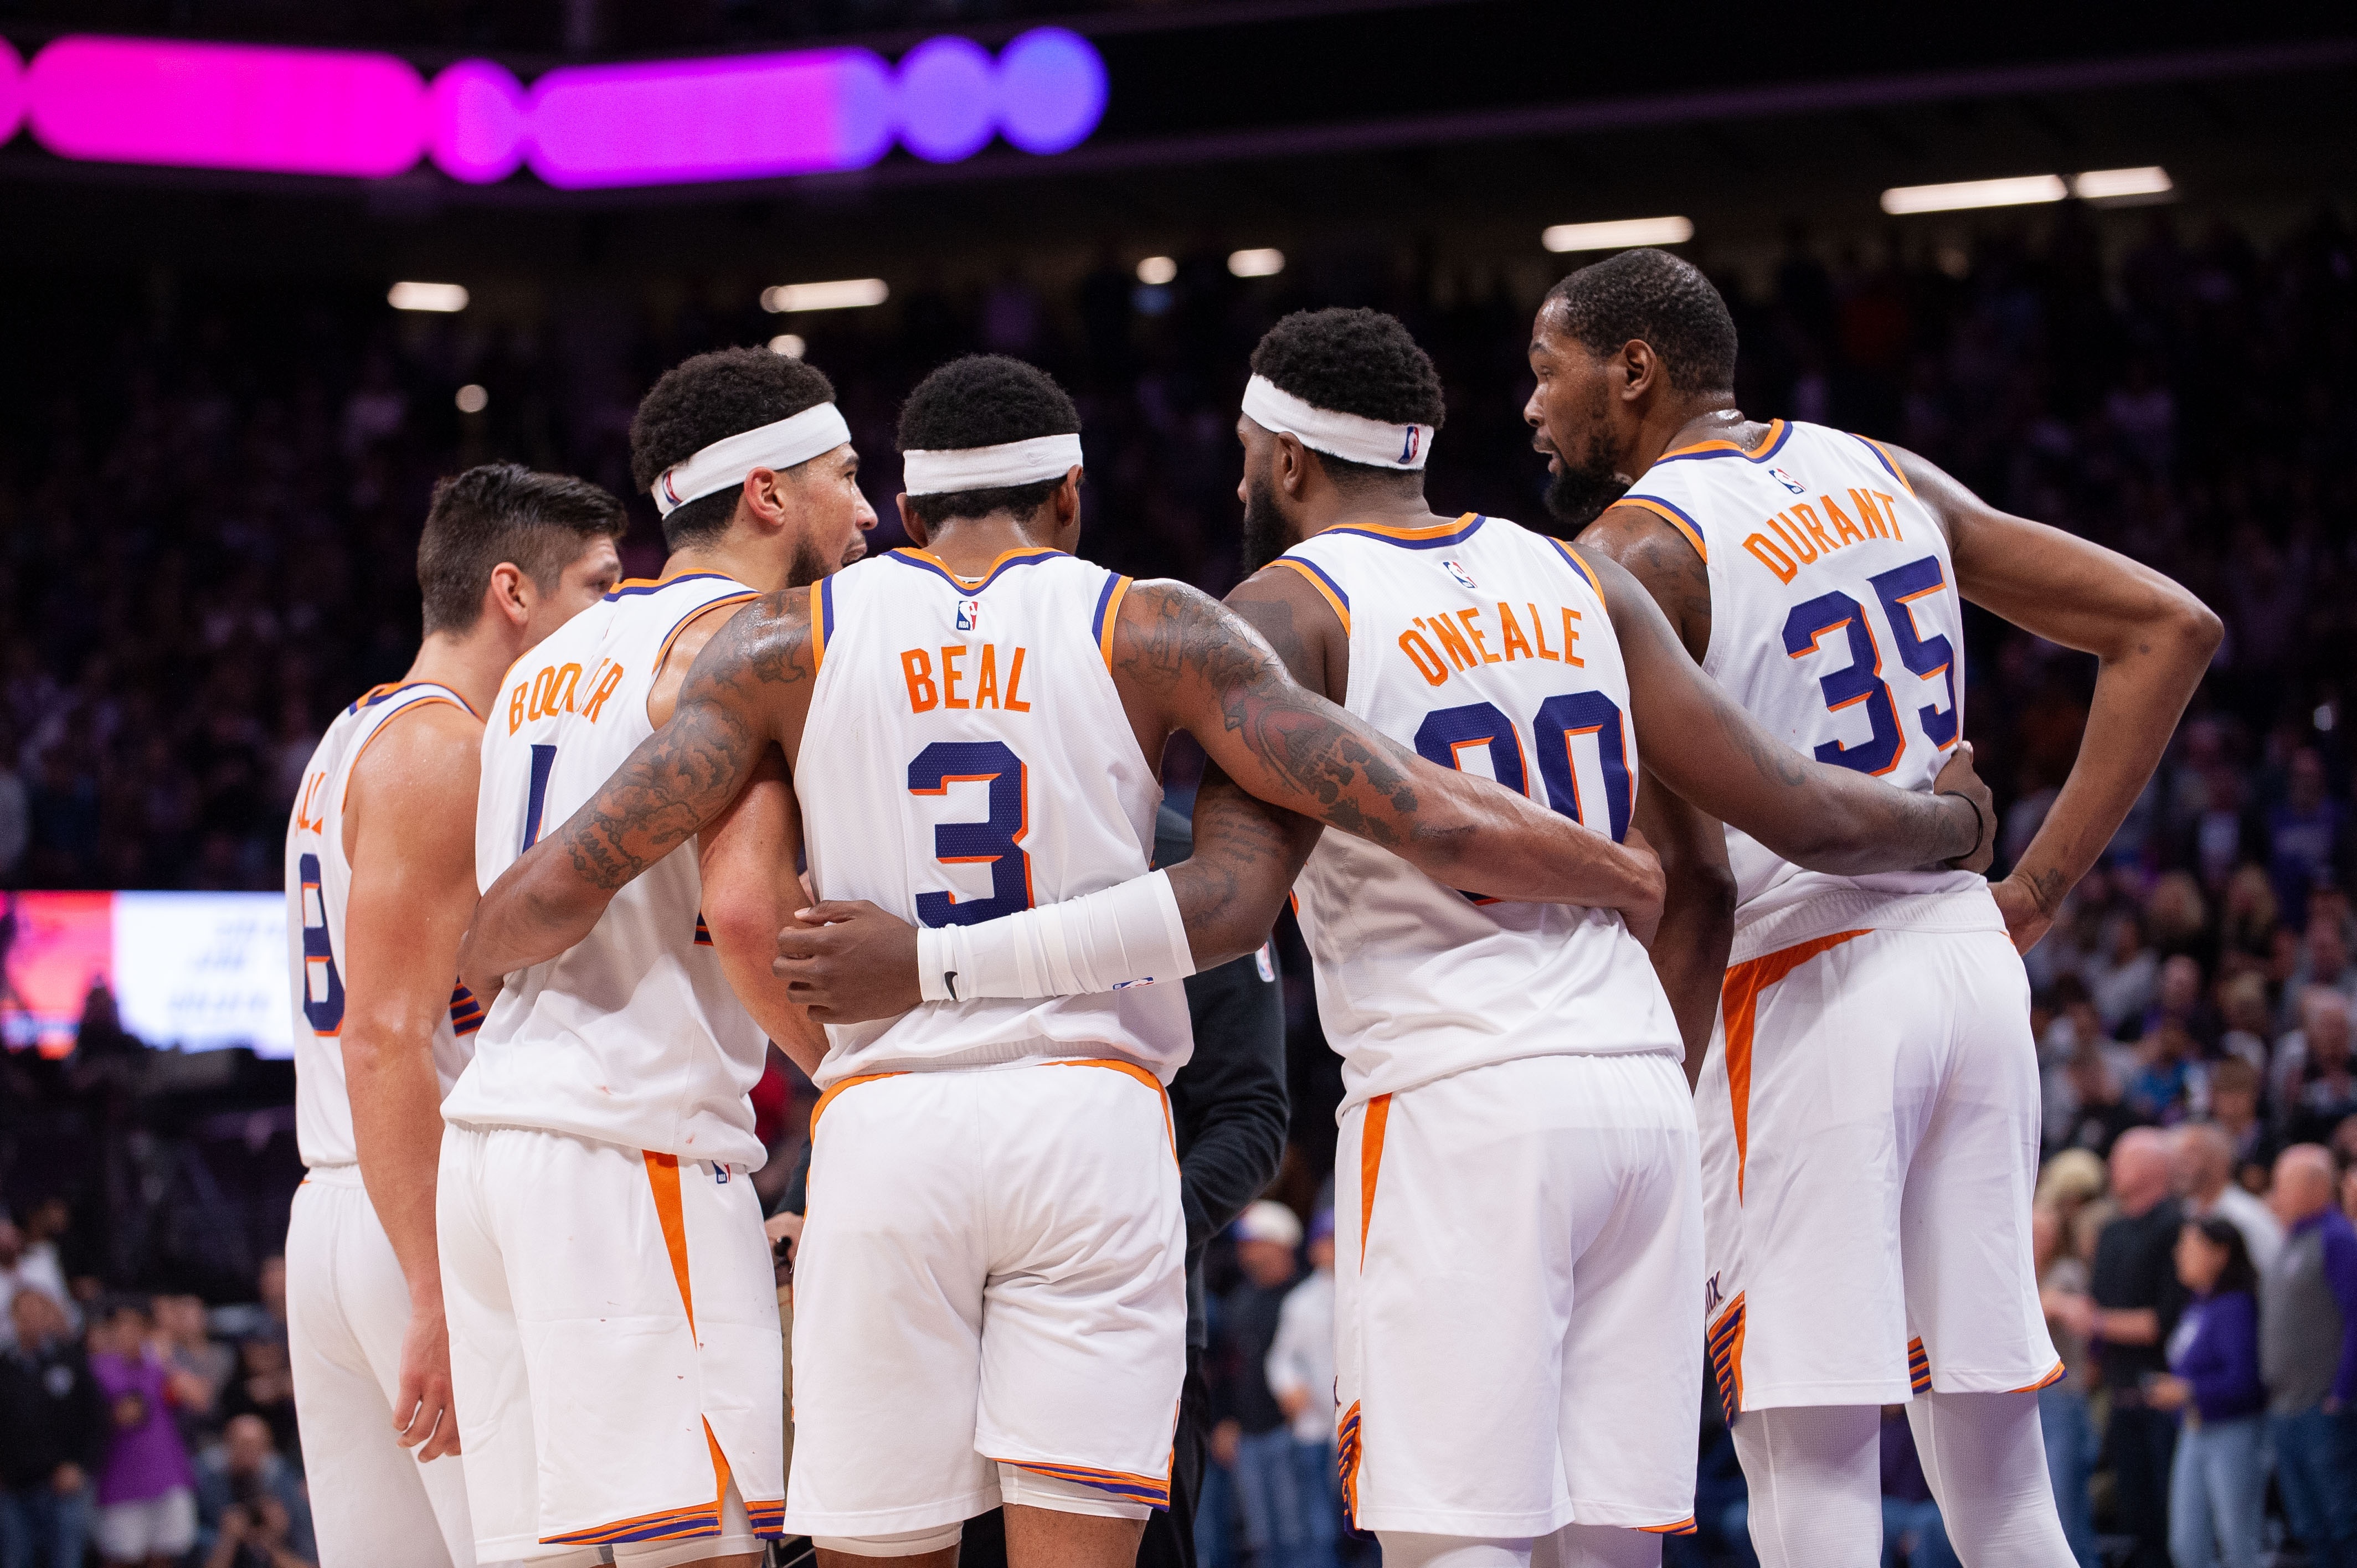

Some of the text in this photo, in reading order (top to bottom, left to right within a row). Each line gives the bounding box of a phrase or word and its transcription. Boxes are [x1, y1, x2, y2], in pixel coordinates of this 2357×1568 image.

[1742, 488, 1904, 586] DURANT
[958, 620, 969, 629] NBA
[1398, 601, 1584, 687] O'NEALE
[1782, 555, 1959, 776] 35
[509, 657, 624, 738] BOOR
[900, 644, 1031, 714] BEAL
[908, 741, 1035, 928] 3
[300, 853, 345, 1038] 8
